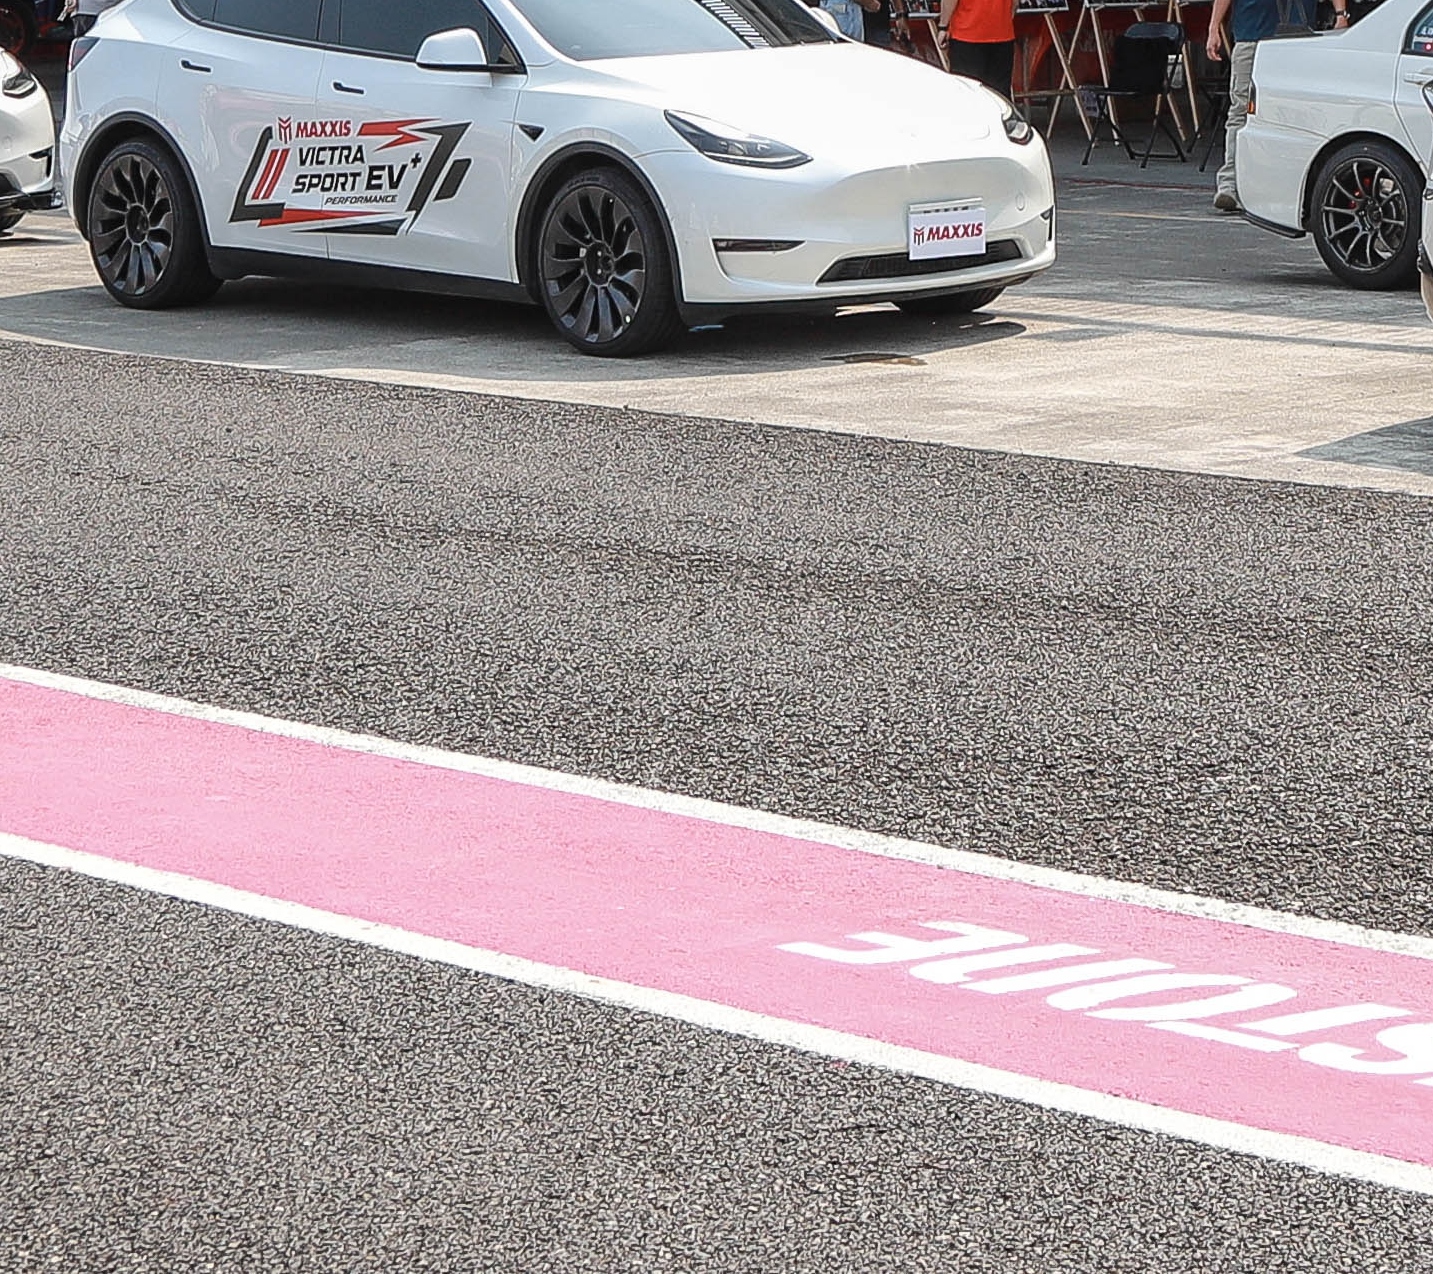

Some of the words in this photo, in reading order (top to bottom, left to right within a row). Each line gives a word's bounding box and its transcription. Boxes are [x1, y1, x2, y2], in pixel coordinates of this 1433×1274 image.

[295, 120, 352, 138] MAXXIS
[299, 145, 365, 166] VICTRA
[292, 172, 362, 194] SPORT
[325, 194, 398, 206] PERFORMANCE
[925, 222, 985, 242] MAXXIS
